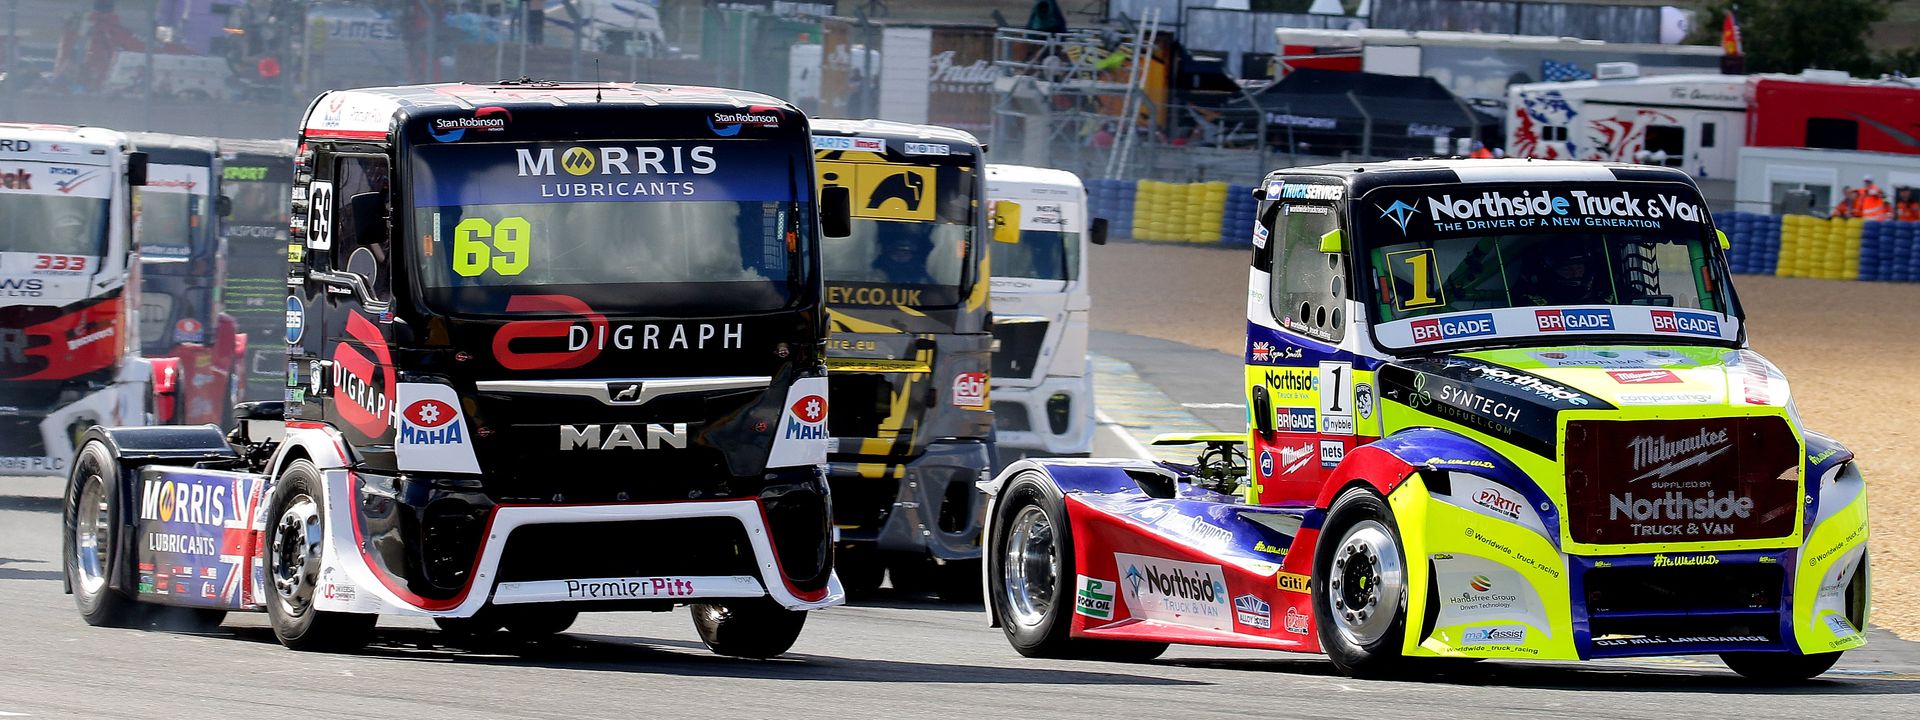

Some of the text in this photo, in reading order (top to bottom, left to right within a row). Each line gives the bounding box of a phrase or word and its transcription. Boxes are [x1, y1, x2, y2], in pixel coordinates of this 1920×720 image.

[436, 117, 504, 128] Stan Robinson
[714, 112, 778, 123] Stan Robinson
[541, 181, 695, 198] LUBRICANTS
[1428, 190, 1706, 224] Northside Truck & Van
[1467, 218, 1516, 230] DRIVER
[1519, 218, 1535, 227] OF
[1552, 217, 1581, 227] NEW
[1584, 217, 1661, 229] GENERATION
[452, 216, 531, 277] 69
[34, 255, 86, 271] 333
[1404, 253, 1437, 307] 1
[824, 286, 922, 306] EY.CO.UK
[1414, 319, 1493, 342] BRIGADE
[1538, 313, 1610, 330] BRIGADE
[1653, 314, 1718, 333] BRIGADE
[568, 323, 743, 351] DIGRAPH
[1269, 346, 1303, 363] Ryan Smith
[1265, 370, 1319, 391] Northside
[1329, 365, 1343, 412] 1
[1469, 364, 1589, 405] Northside
[1480, 373, 1520, 388] TRUCK
[1535, 390, 1559, 402] VAN
[333, 359, 397, 430] DIGRAPH
[1440, 385, 1521, 423] SYNTECH
[1277, 413, 1315, 429] BRIGADE
[1330, 419, 1352, 431] nybble
[1437, 403, 1513, 437] BIOFUEL.COM
[400, 418, 463, 445] MAHA
[559, 422, 688, 451] MAN
[1322, 445, 1343, 459] nets
[1626, 427, 1729, 471] Milwaukee
[1651, 480, 1712, 489] SUPPLIED BY
[1609, 489, 1755, 522] Northside
[1630, 522, 1734, 536] TRUCK & VAN
[149, 532, 215, 556] LUBRICANTS
[1474, 532, 1512, 555] Worldwide
[1144, 564, 1225, 604] Northside
[1279, 575, 1302, 590] Giti
[1077, 595, 1111, 611] ROCK OIL
[1164, 598, 1219, 616] TRUCK & VAN
[1450, 593, 1516, 604] Handsfree Group
[1447, 645, 1485, 653] Worldwide
